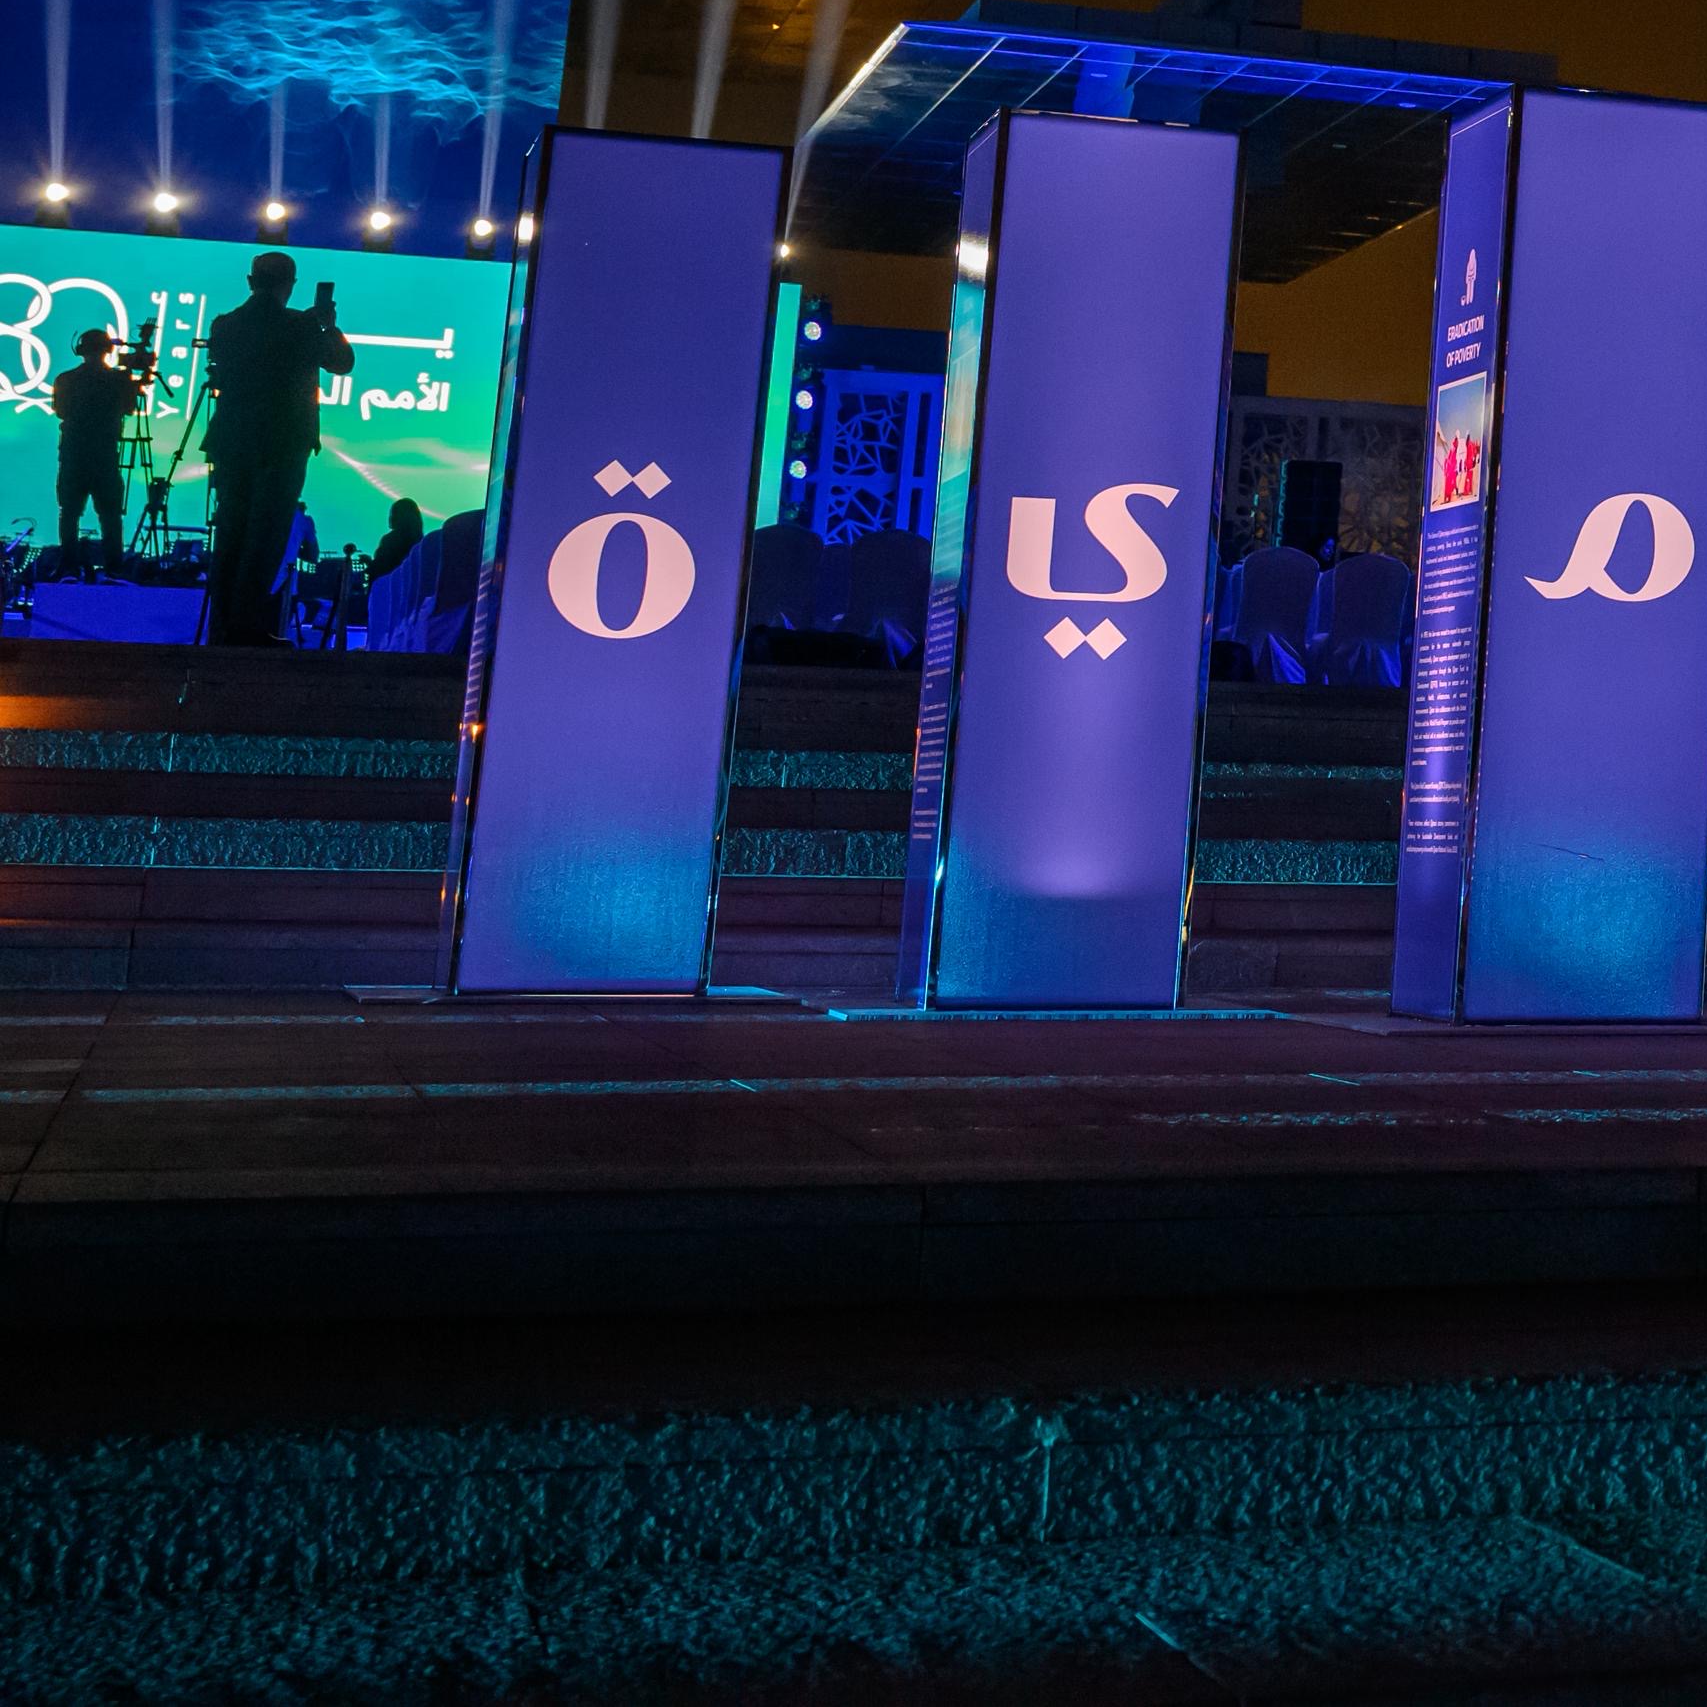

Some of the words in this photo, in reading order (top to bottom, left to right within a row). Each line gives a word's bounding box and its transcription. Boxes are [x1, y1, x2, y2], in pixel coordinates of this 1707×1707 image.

[156, 292, 195, 419] Years
[1447, 351, 1455, 368] OF
[1454, 342, 1482, 365] POVERTY
[1448, 315, 1484, 342] ERADICATION
[360, 372, 450, 421] الأمم
[548, 460, 695, 638] ة
[1007, 484, 1179, 660] ي
